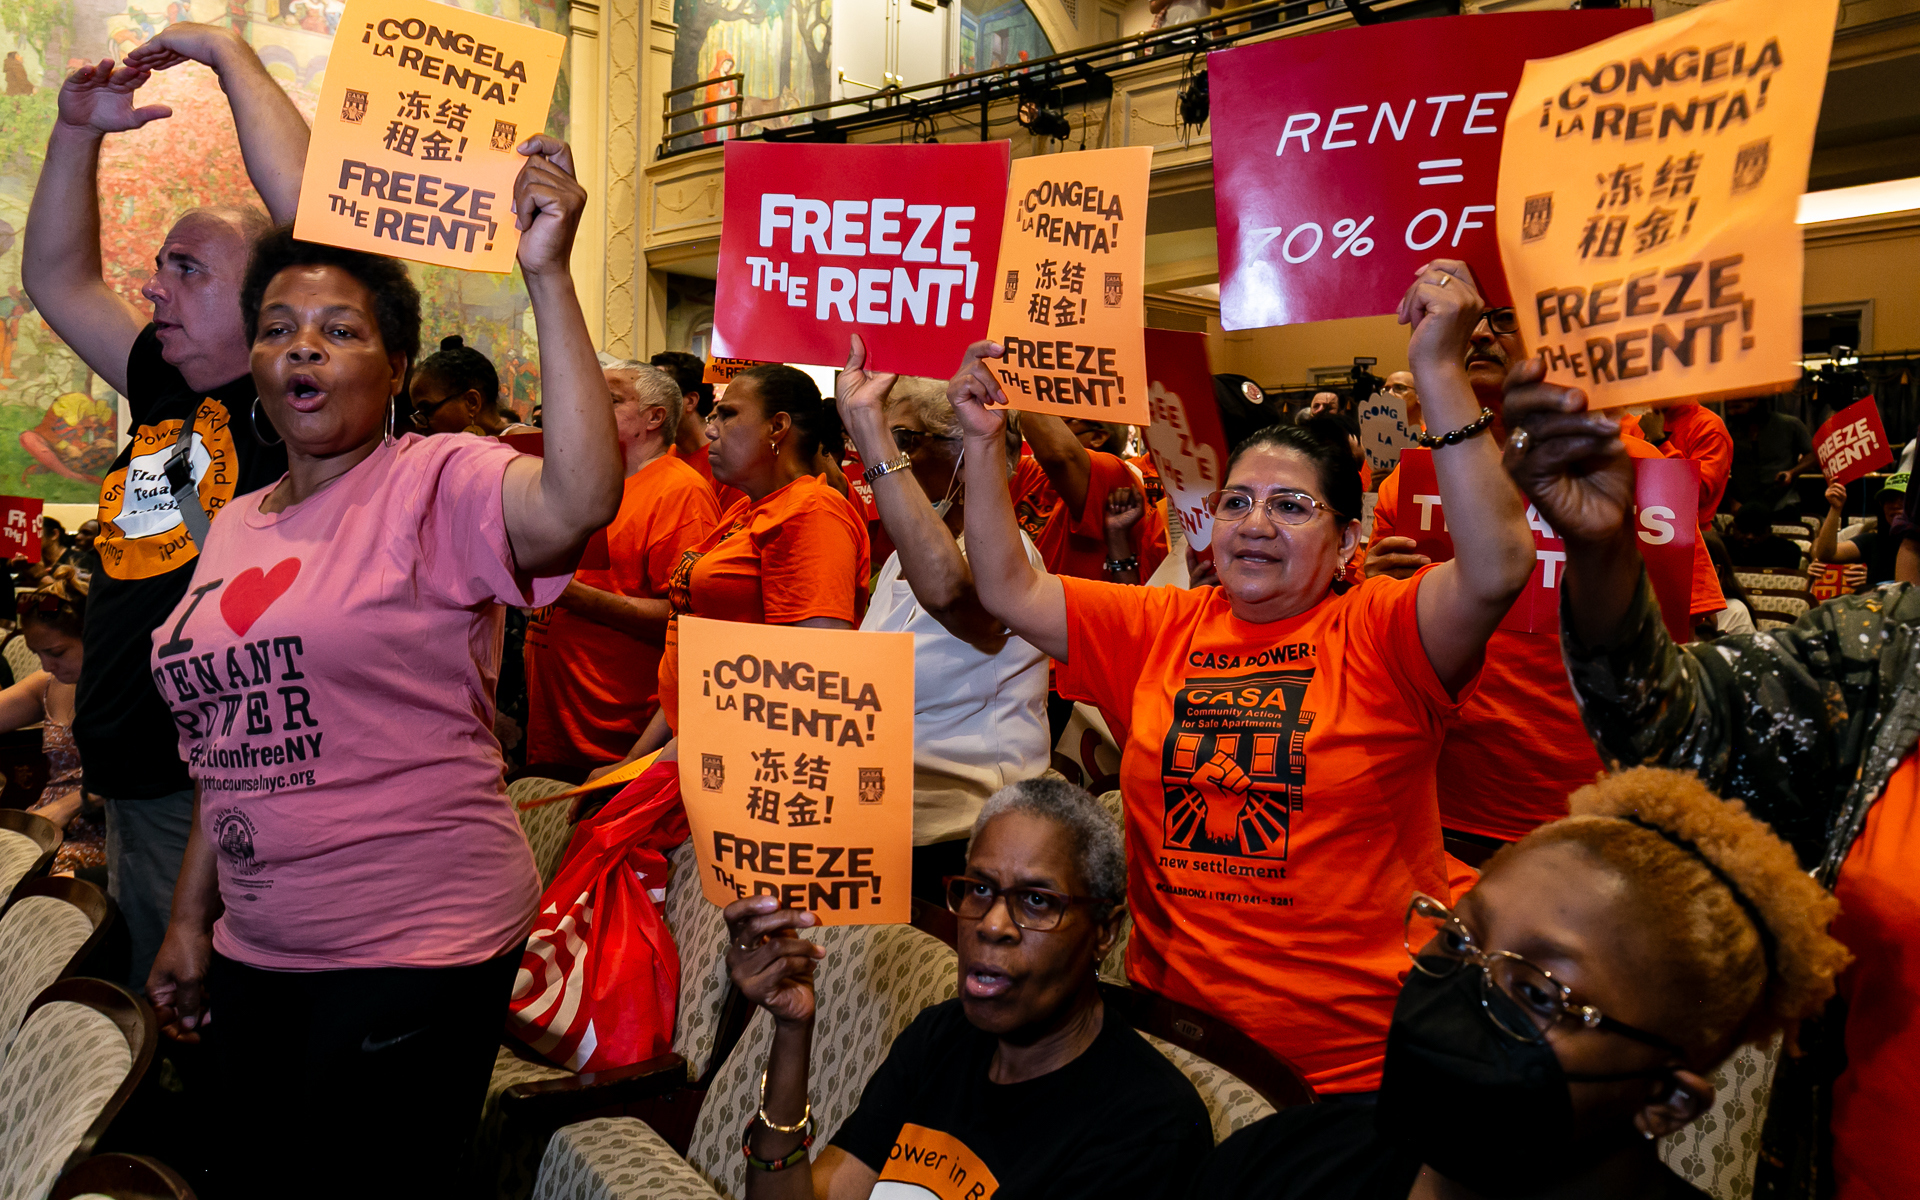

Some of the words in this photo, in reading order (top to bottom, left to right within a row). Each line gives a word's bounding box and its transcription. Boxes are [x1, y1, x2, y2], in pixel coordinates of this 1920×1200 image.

[362, 18, 527, 83] ¡CONGELA
[373, 43, 395, 58] LA
[398, 45, 519, 106] RENTA!
[1539, 35, 1784, 130] ¡CONGELA
[397, 90, 472, 132] 冻结
[1275, 91, 1508, 157] RENTE
[1555, 112, 1585, 138] LA
[1592, 73, 1771, 143] RENTA!
[383, 120, 468, 162] 租金!
[339, 158, 496, 222] FREEZE
[1016, 180, 1124, 222] ¡CONGELA
[1596, 150, 1704, 209] 冻结
[328, 194, 370, 228] THE
[373, 207, 498, 253] RENT!
[759, 193, 976, 265] FREEZE
[1022, 216, 1034, 233] LA
[1036, 213, 1119, 254] RENTA!
[1248, 215, 1375, 268] 70%
[1577, 197, 1700, 261] 租金!
[746, 256, 809, 308] THE
[816, 261, 980, 327] RENT!
[1035, 258, 1086, 295] 冻结
[1536, 252, 1745, 337] FREEZE
[1028, 293, 1088, 328] 租金!
[1002, 336, 1118, 377] FREEZE
[1537, 344, 1587, 378] THE
[1585, 299, 1756, 385] RENT!
[712, 365, 724, 376] THE
[998, 369, 1031, 395] THE
[1033, 375, 1127, 408] RENT!
[1366, 448, 1397, 468] RENT
[1378, 432, 1393, 446] LA
[1817, 417, 1870, 466] FREEZE
[1828, 431, 1880, 477] RENT!
[213, 449, 232, 486] and
[158, 578, 223, 659] I
[154, 635, 305, 707] TENANT
[1188, 651, 1241, 670] CASA
[1244, 642, 1317, 668] POWER!
[703, 654, 882, 712] ¡CONGELA
[1186, 687, 1287, 711] CASA
[173, 685, 318, 739] POWER
[716, 694, 738, 711] LA
[743, 692, 876, 747] RENTA!
[1181, 719, 1195, 728] for
[1198, 719, 1219, 729] Safe
[1221, 719, 1283, 730] Apartments
[1186, 707, 1243, 718] Community
[1245, 709, 1281, 719] Action
[751, 748, 831, 791] 冻结
[746, 786, 834, 827] 租金!
[713, 831, 874, 878] FREEZE
[1158, 856, 1188, 869] new
[1192, 858, 1287, 879] settlement
[711, 864, 747, 899] THE
[889, 1143, 948, 1170] ower
[949, 1156, 967, 1188] in
